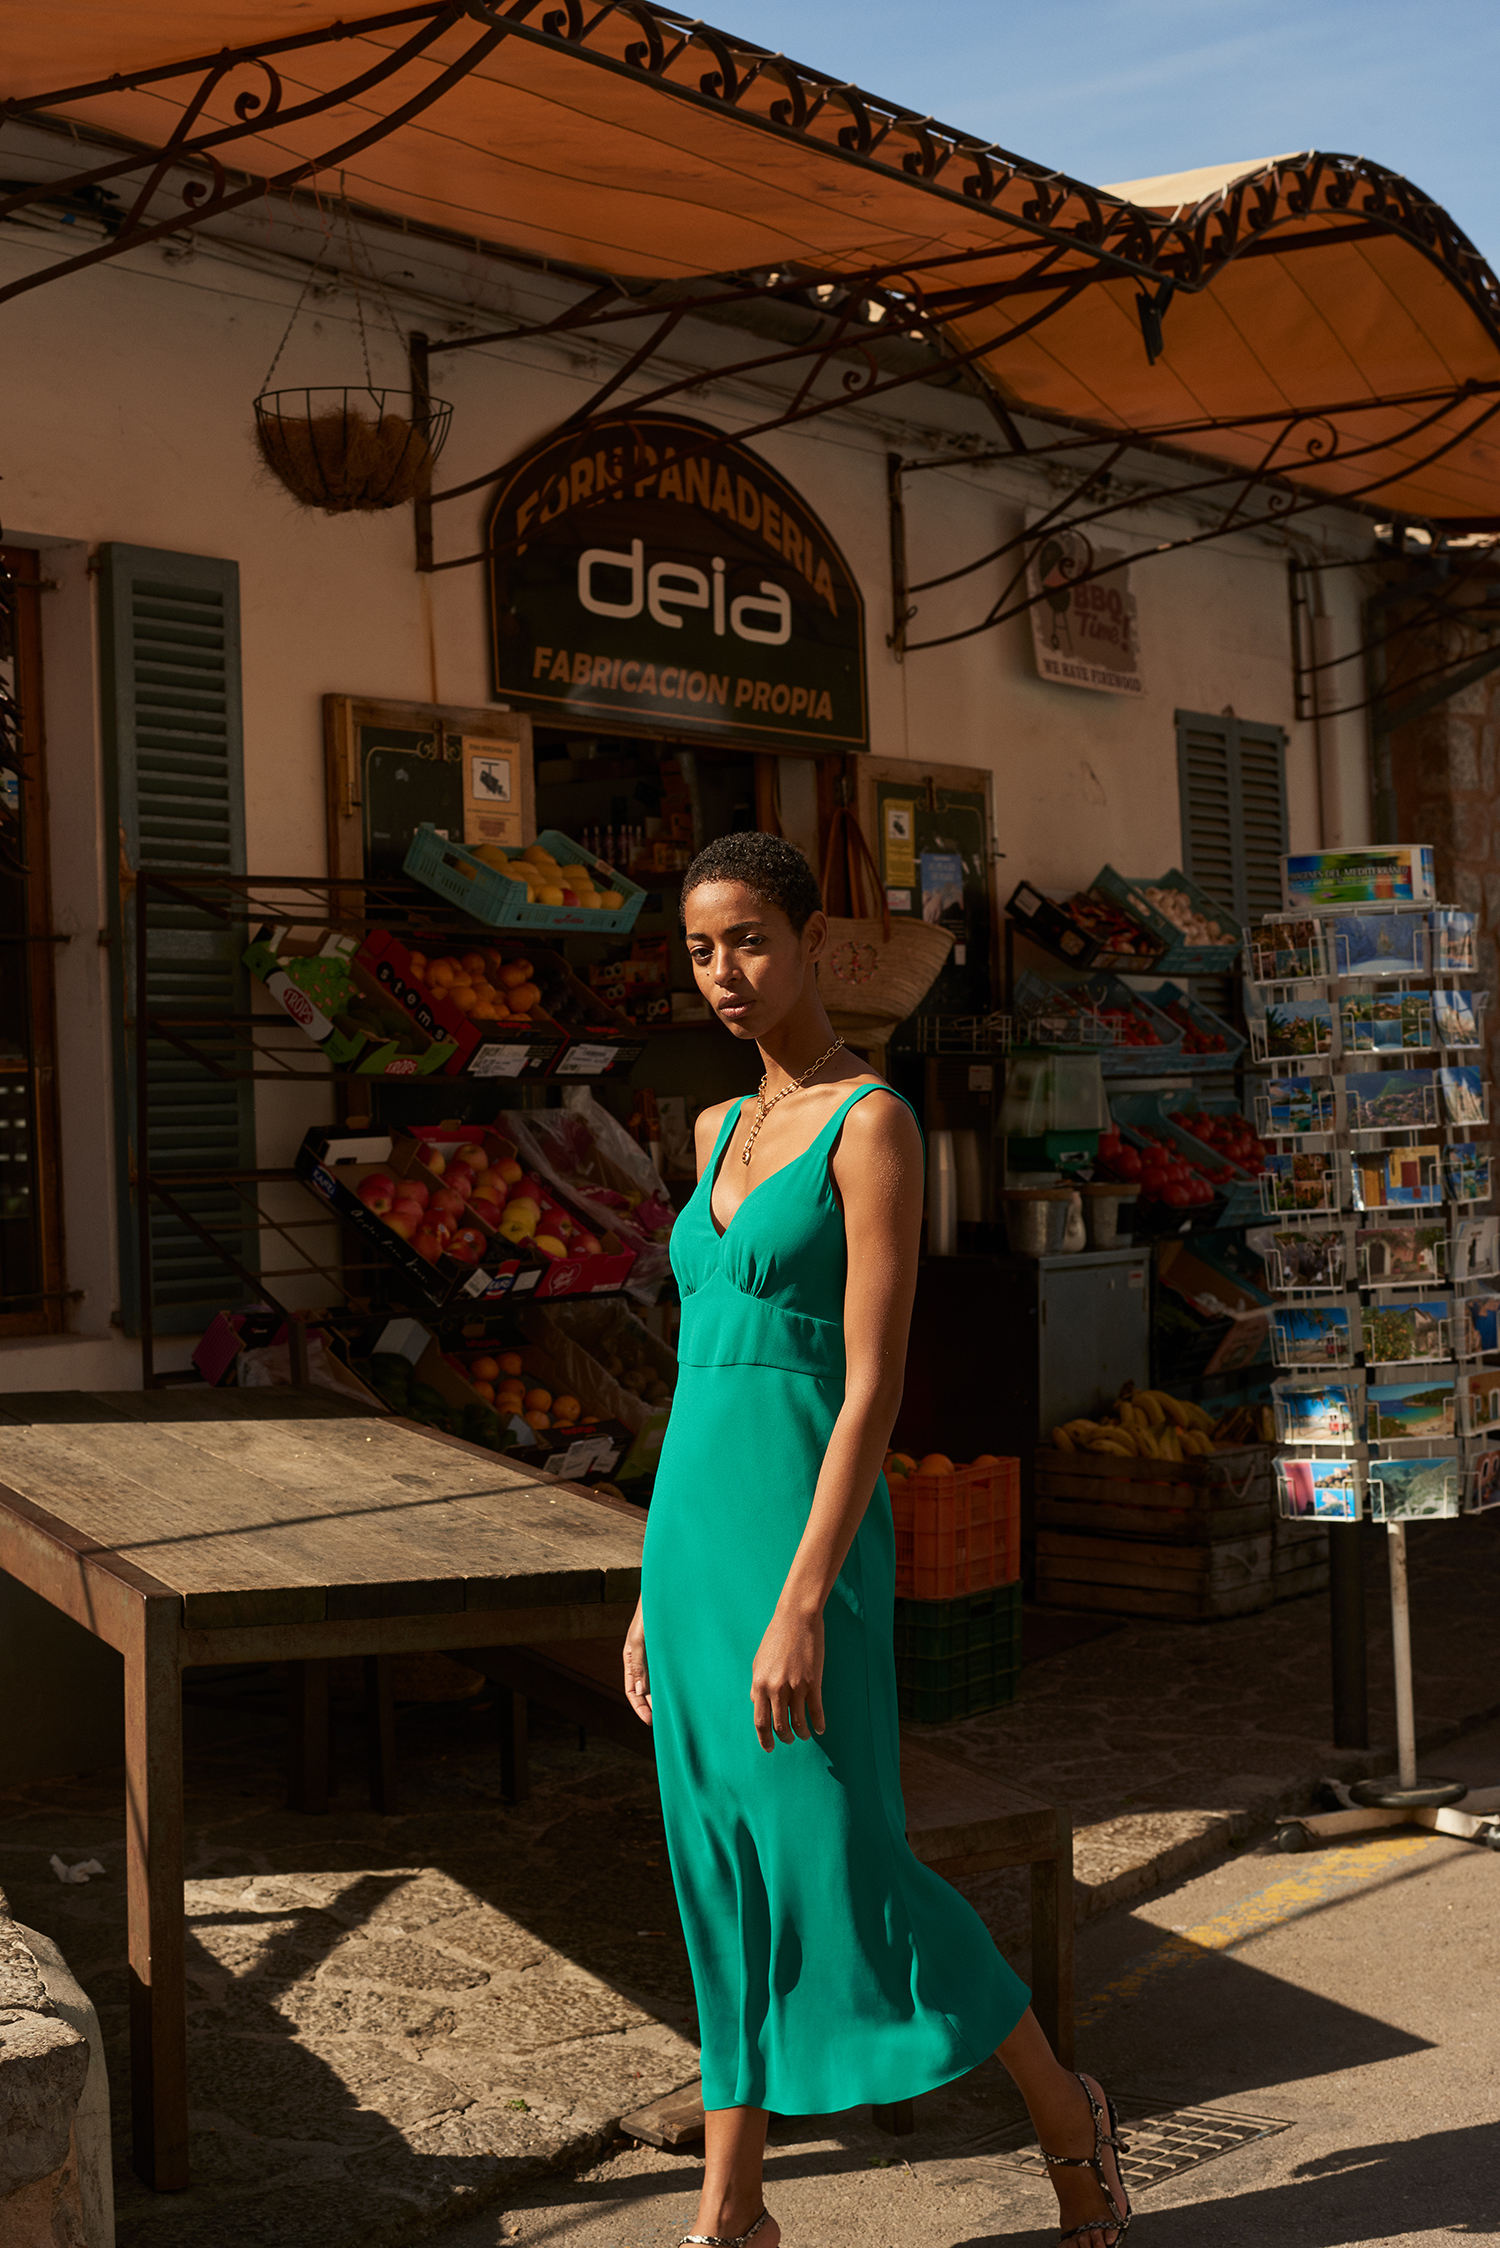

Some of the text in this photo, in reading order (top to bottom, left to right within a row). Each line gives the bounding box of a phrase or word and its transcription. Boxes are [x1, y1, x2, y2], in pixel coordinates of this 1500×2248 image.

[633, 444, 839, 619] PANADERIA
[578, 538, 792, 646] deia
[1073, 583, 1124, 625] BBQ
[532, 645, 834, 722] FABRICACION PROPIA
[283, 990, 314, 1023] TROPS
